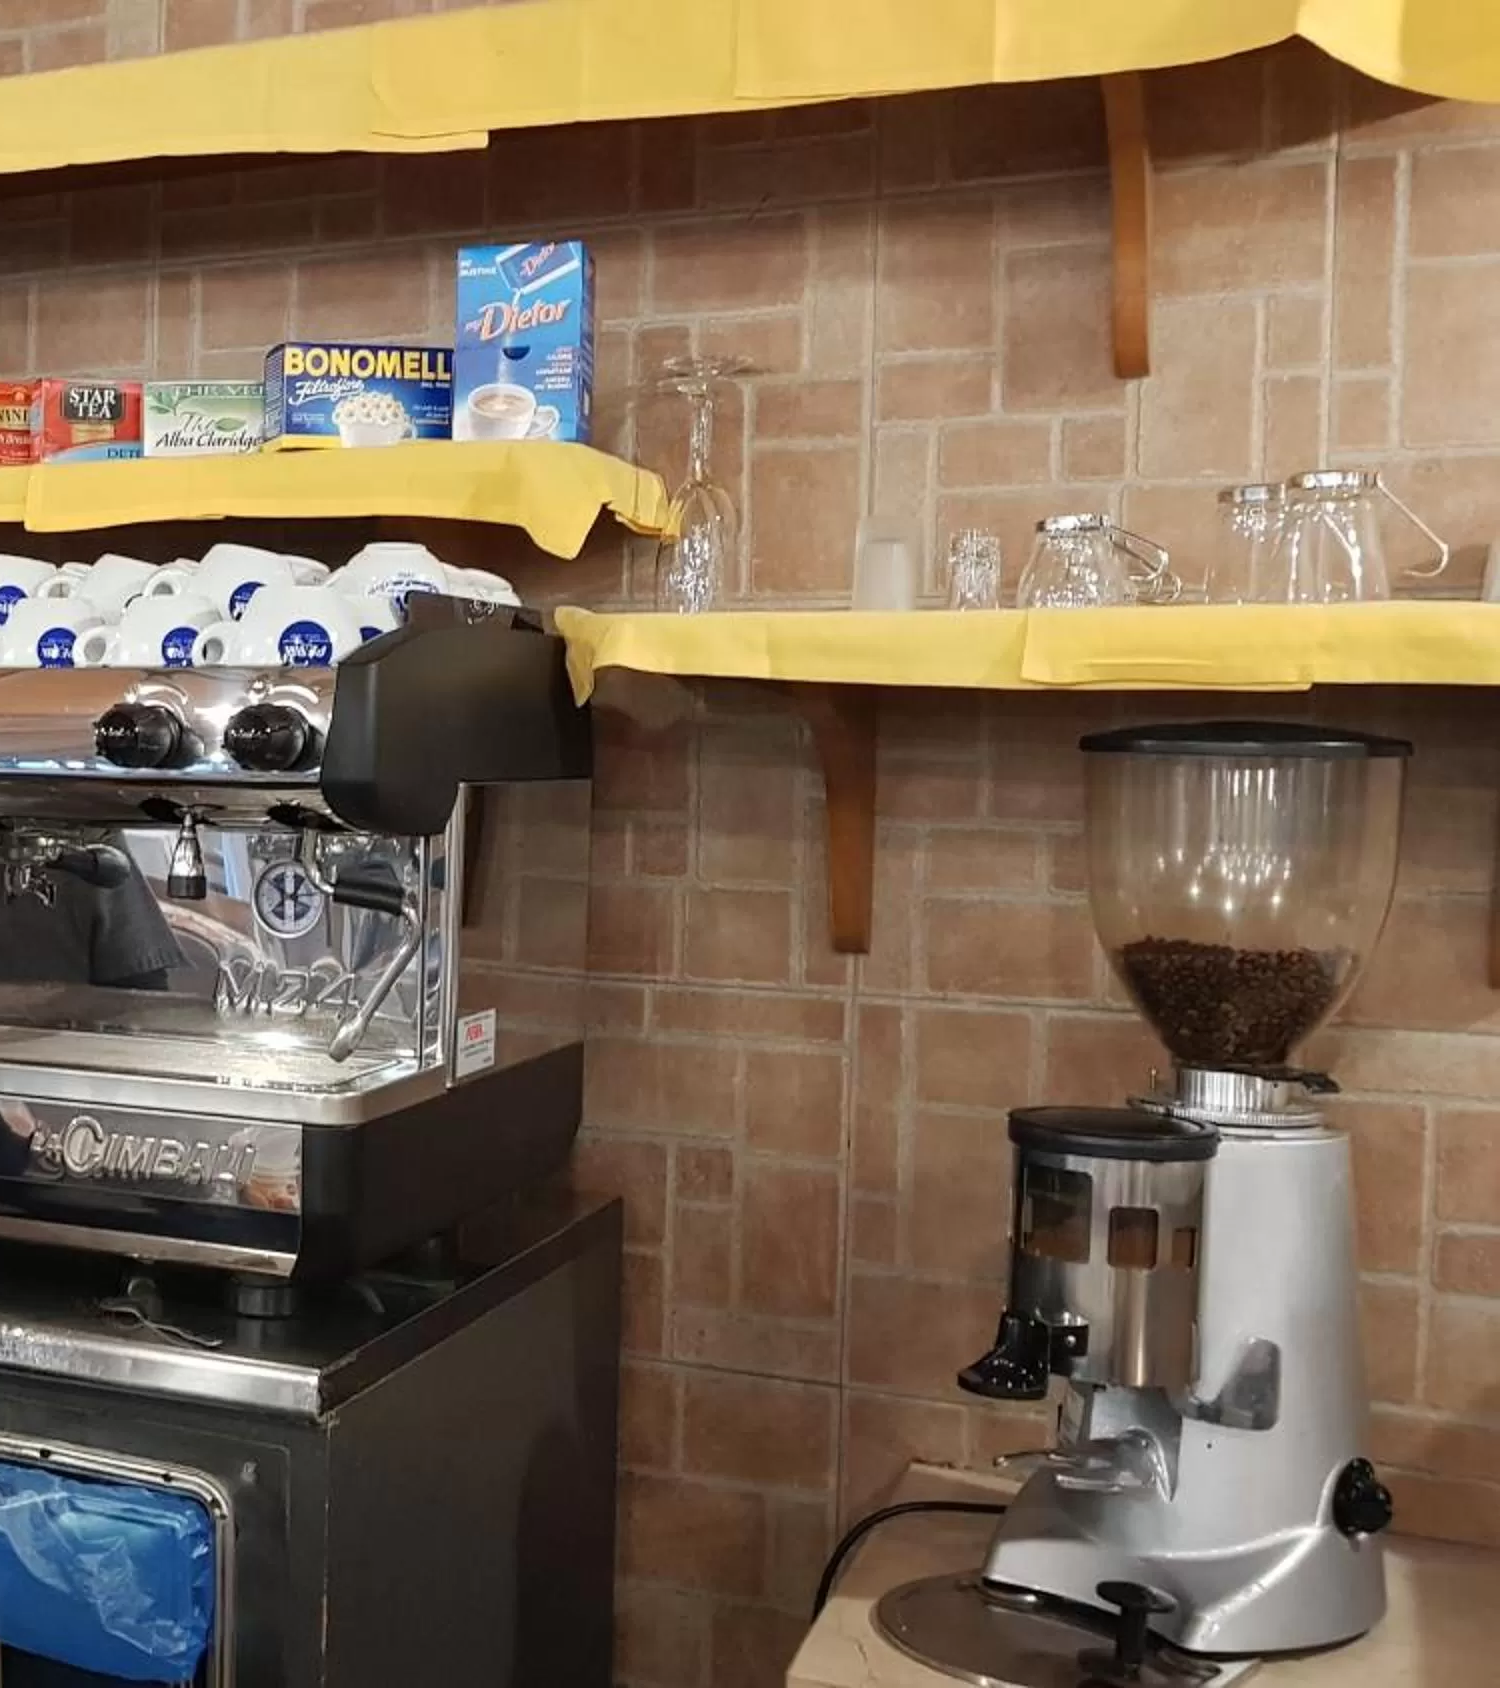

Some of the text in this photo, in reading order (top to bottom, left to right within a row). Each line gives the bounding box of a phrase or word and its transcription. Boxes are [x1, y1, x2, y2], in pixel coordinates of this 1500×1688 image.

[478, 299, 572, 341] Dietor
[69, 388, 116, 404] STAR
[73, 401, 112, 418] TEA
[155, 430, 260, 453] Alba Claridge
